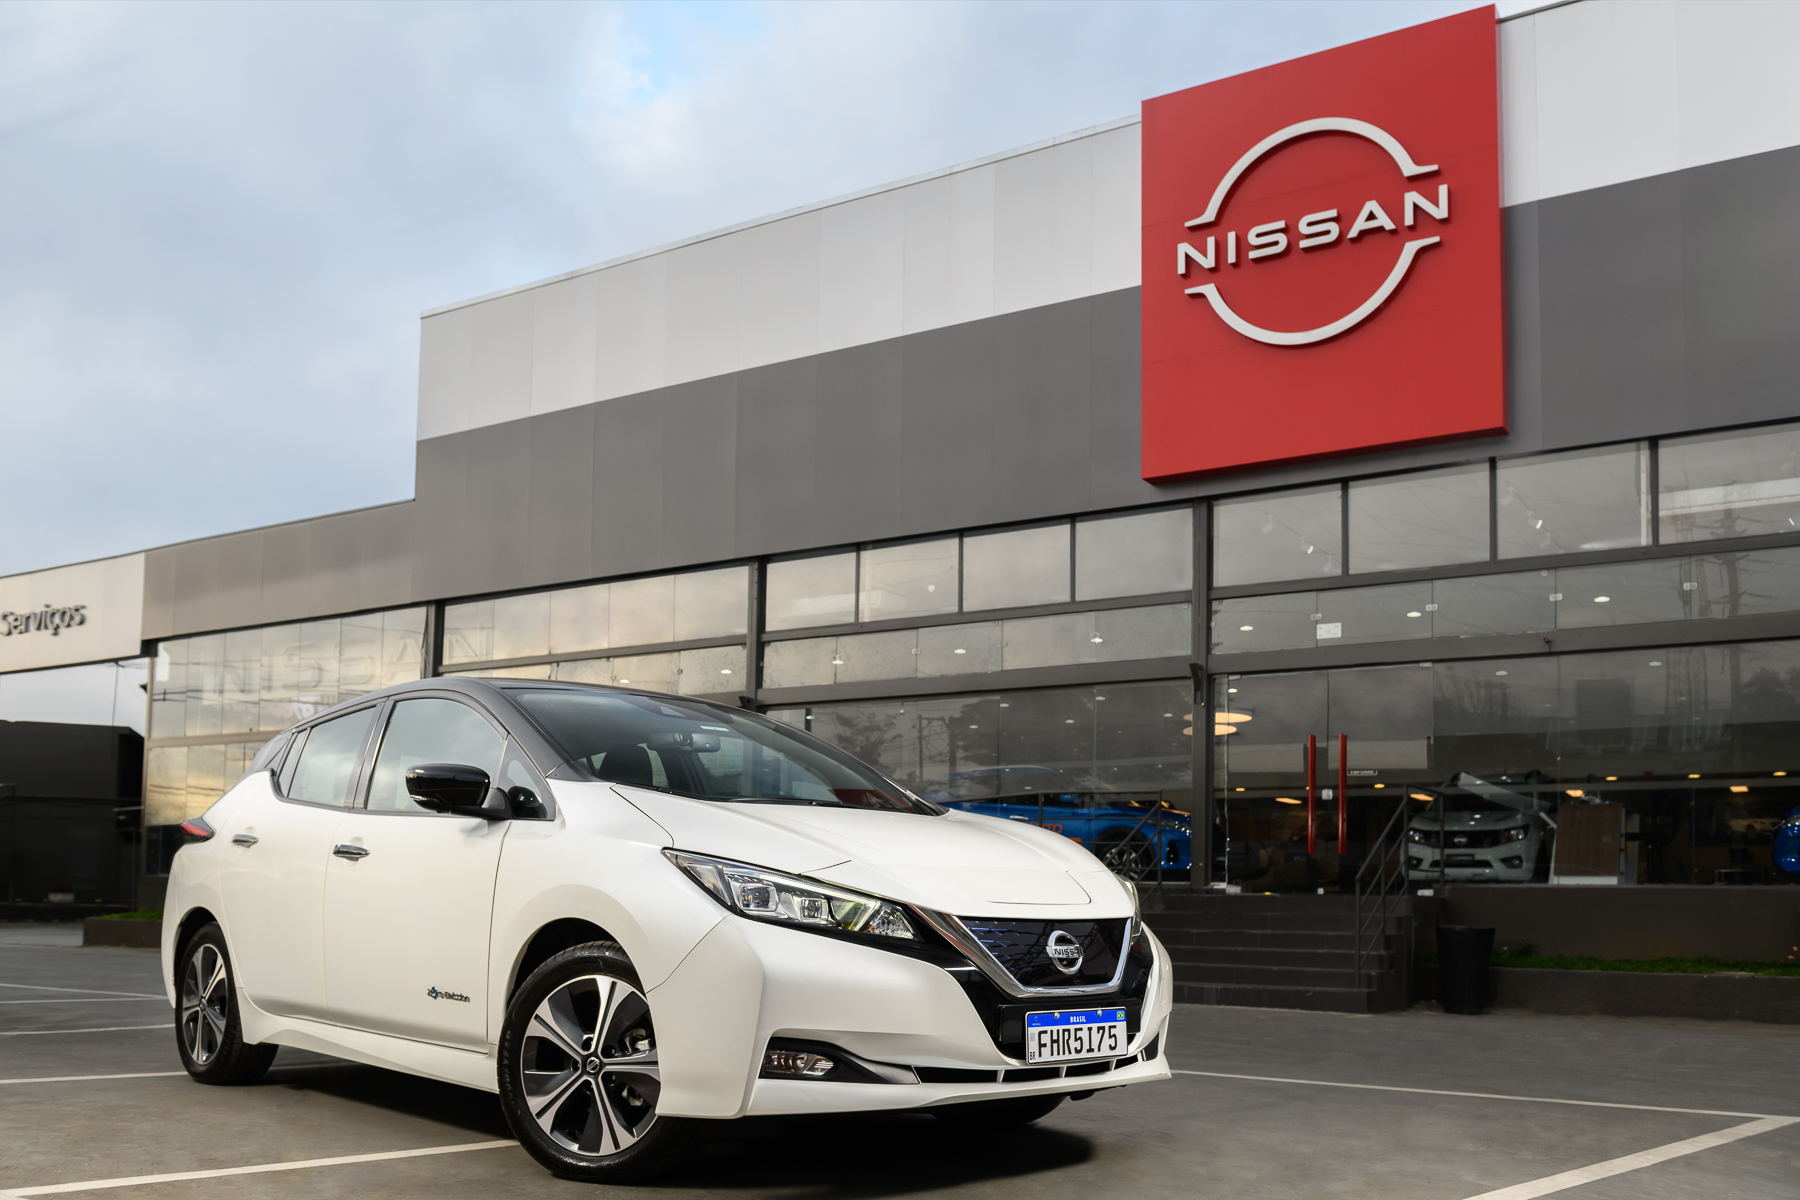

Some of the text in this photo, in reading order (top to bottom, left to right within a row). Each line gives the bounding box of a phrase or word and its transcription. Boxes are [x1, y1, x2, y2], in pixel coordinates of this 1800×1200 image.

[1177, 183, 1449, 276] NISSAN
[0, 604, 86, 636] Serviços
[1070, 1015, 1087, 1024] BRASIL
[1037, 1025, 1118, 1058] FHR5I75
